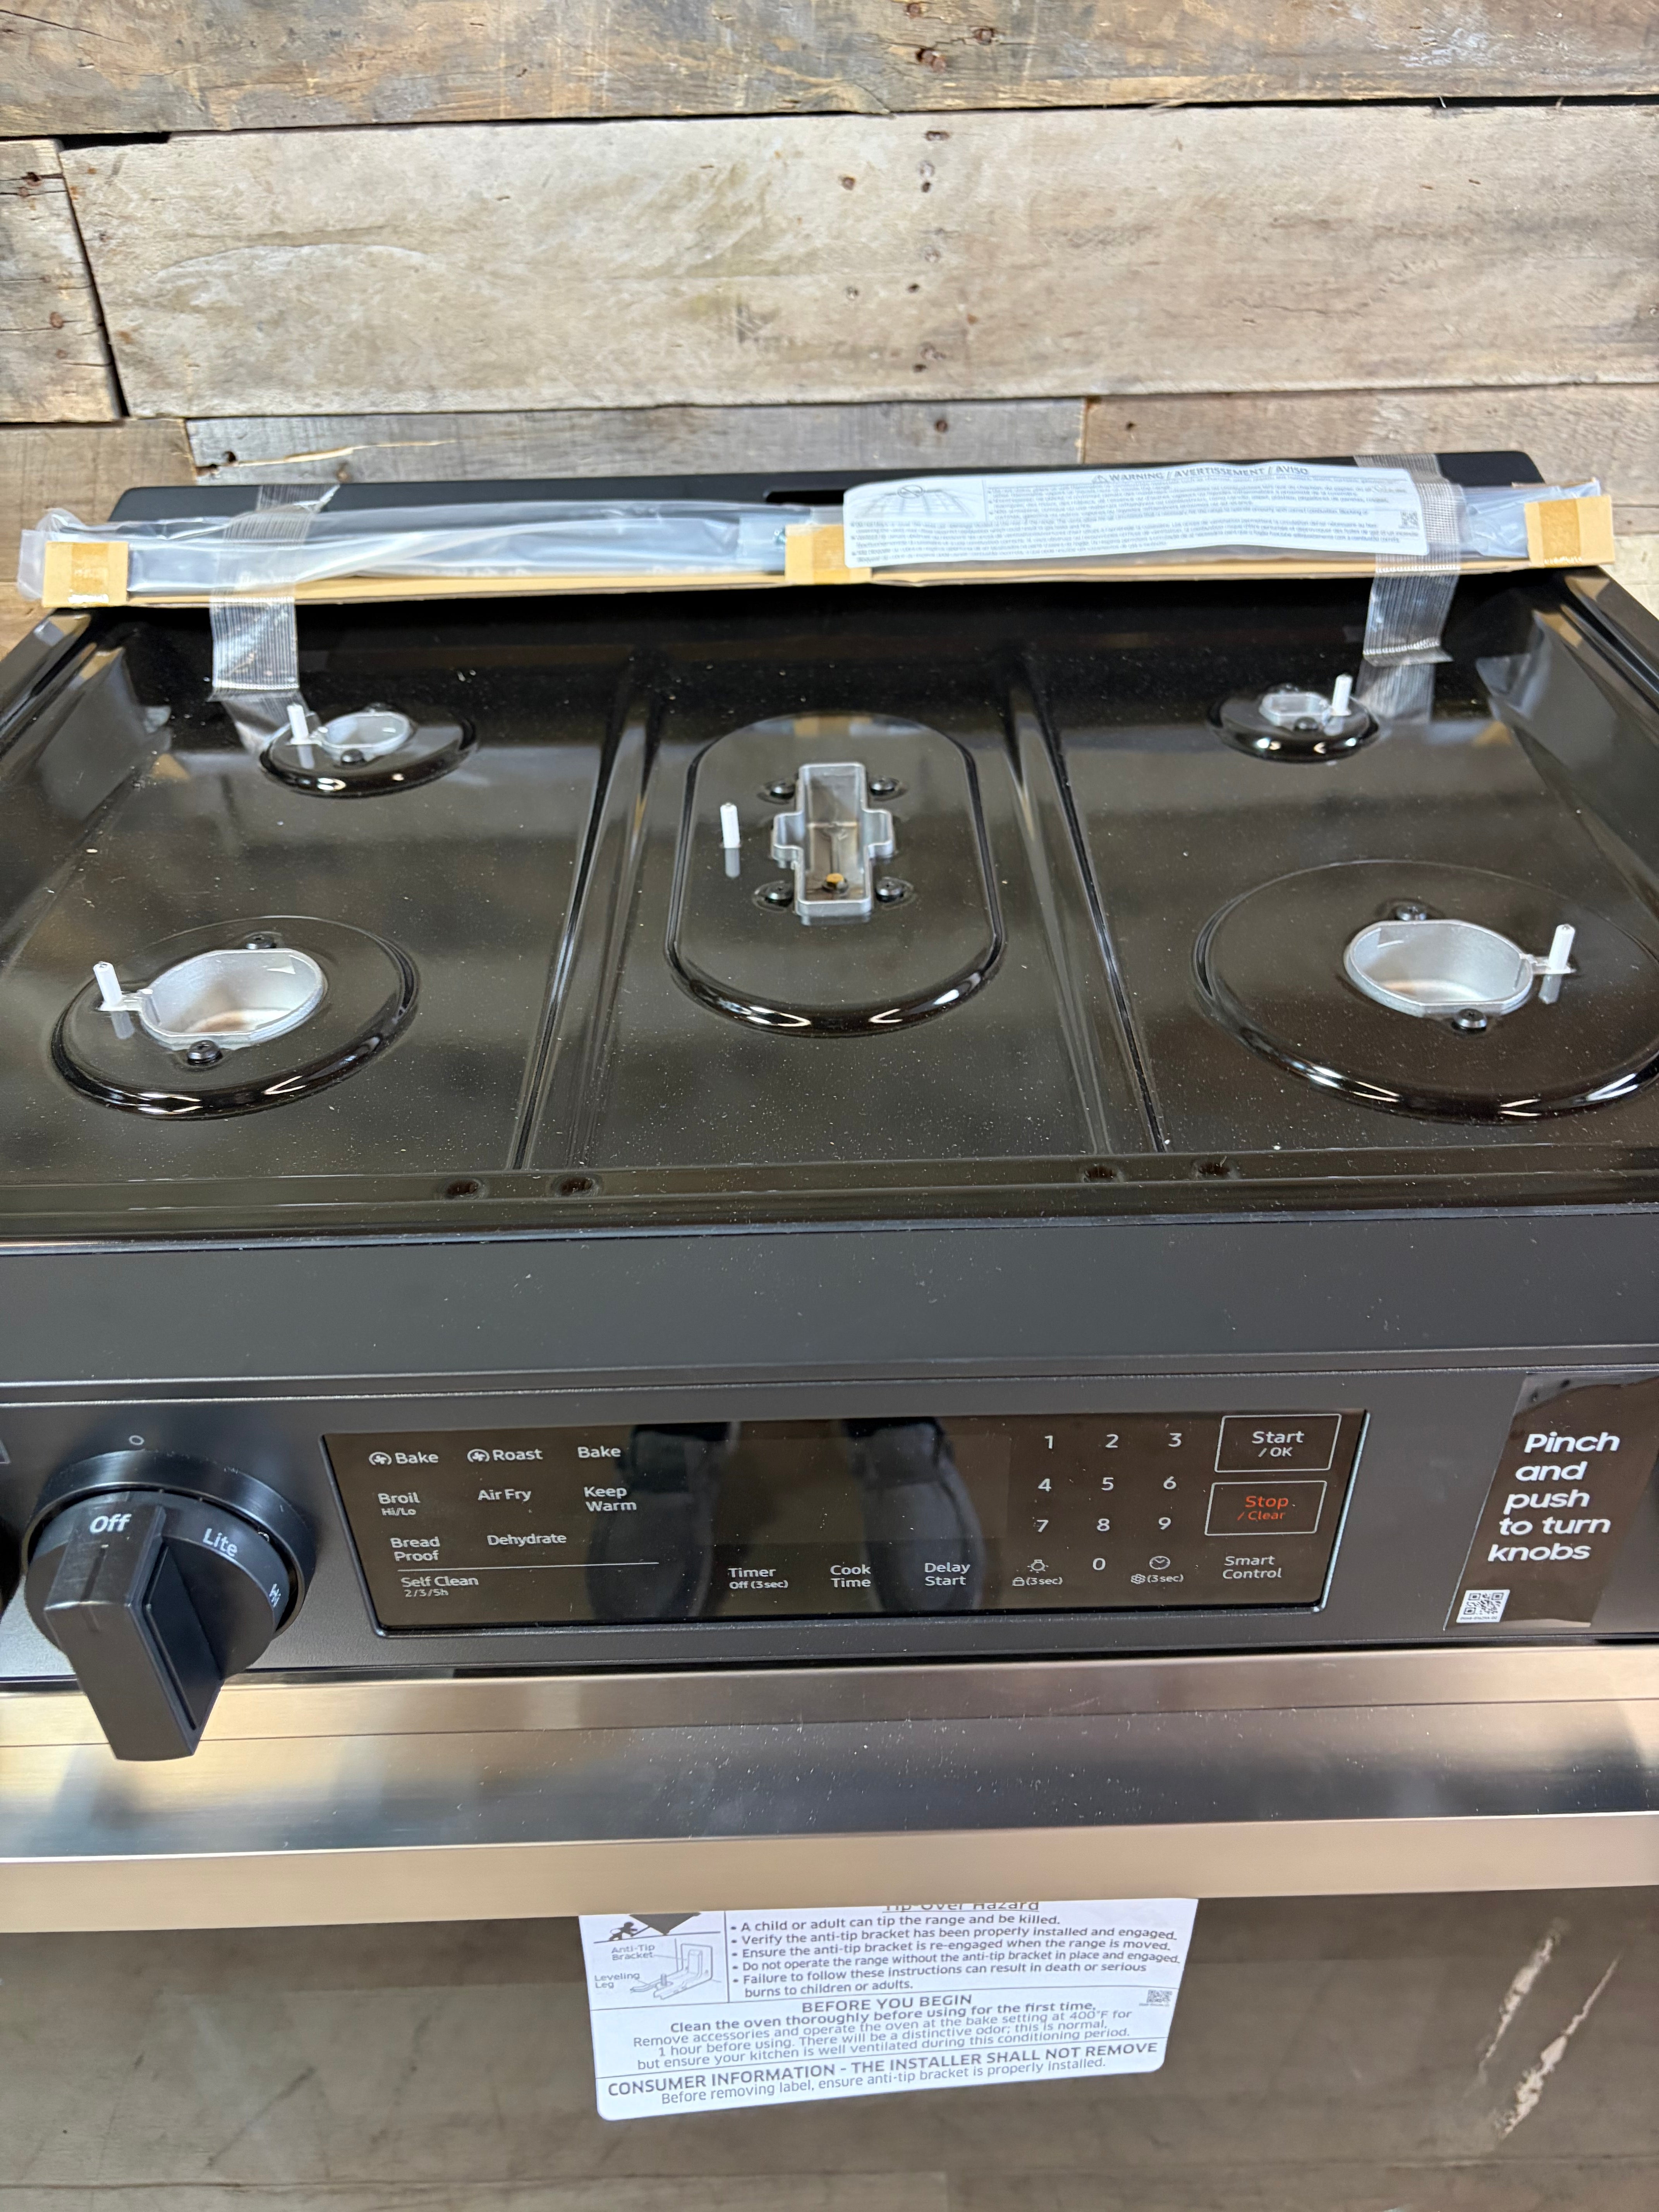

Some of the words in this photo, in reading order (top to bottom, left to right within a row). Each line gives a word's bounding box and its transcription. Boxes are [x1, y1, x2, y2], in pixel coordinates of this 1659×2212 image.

[1109, 472, 1162, 481] WARNING
[1174, 467, 1264, 478] AVERTISSEMENT
[1276, 465, 1309, 475] AVISO
[1044, 1435, 1053, 1449] 1
[1105, 1434, 1119, 1448] 2
[1168, 1433, 1182, 1447] 3
[1252, 1431, 1304, 1444] Start
[1524, 1432, 1620, 1453] Pinch
[395, 1451, 438, 1464] Bake
[493, 1449, 543, 1461] Roast
[578, 1446, 621, 1458] Bake
[1516, 1462, 1588, 1482] and
[1038, 1478, 1051, 1492] 4
[1101, 1477, 1114, 1491] 5
[1163, 1476, 1176, 1490] 6
[378, 1492, 421, 1504] Broil
[478, 1489, 502, 1501] Air
[505, 1489, 531, 1502] Fry
[584, 1486, 627, 1499] Keep
[586, 1501, 637, 1511] Warm
[1245, 1496, 1289, 1510] Stop
[1504, 1489, 1590, 1515] push
[381, 1508, 416, 1516] Hi/Lo
[1036, 1519, 1049, 1532] 7
[1097, 1518, 1110, 1531] 8
[1158, 1517, 1171, 1530] 9
[1499, 1517, 1533, 1535] to
[1542, 1517, 1611, 1534] turn
[89, 1513, 132, 1534] Off
[203, 1528, 238, 1557] Lite
[487, 1534, 567, 1547] Dehydrate
[390, 1536, 440, 1548] Bread
[394, 1550, 439, 1561] Proof
[1487, 1543, 1592, 1562] knobs
[1092, 1558, 1106, 1570] 0
[1224, 1555, 1275, 1566] Smart
[728, 1567, 776, 1578] Timer
[830, 1564, 871, 1575] Cook
[924, 1562, 970, 1574] Delay
[1223, 1568, 1281, 1579] Control
[400, 1576, 431, 1587] Self
[434, 1575, 479, 1587] Clean
[729, 1581, 749, 1589] Off
[831, 1577, 871, 1587] Time
[925, 1576, 967, 1586] Start
[741, 1922, 751, 1932] A
[755, 1921, 787, 1931] child
[792, 1922, 806, 1930] or
[811, 1918, 845, 1929] adult
[850, 1919, 872, 1927] can
[877, 1916, 895, 1927] tip
[899, 1916, 921, 1925] the
[926, 1917, 965, 1926] range
[969, 1915, 994, 1923] and
[999, 1914, 1015, 1923] be
[1019, 1915, 1060, 1924] killed.
[742, 1934, 782, 1946] Verify
[786, 1934, 807, 1943] the
[811, 1931, 857, 1942] anti-tip
[862, 1929, 910, 1939] bracket
[914, 1929, 935, 1937] has
[939, 1928, 970, 1937] been
[974, 1927, 1029, 1938] properly
[1033, 1927, 1087, 1936] installed
[1119, 1930, 1177, 1940] engaged.
[611, 1944, 655, 1953] Anti-Tip
[743, 1949, 786, 1958] Ensure
[790, 1947, 810, 1956] the
[814, 1944, 860, 1955] anti-tip
[865, 1942, 912, 1952] bracket
[917, 1941, 926, 1950] is
[930, 1939, 1002, 1951] re-engaged
[1007, 1939, 1041, 1947] when
[1046, 1939, 1065, 1947] the
[1069, 1941, 1106, 1949] range
[1109, 1939, 1119, 1948] is
[1123, 1941, 1170, 1950] moved.
[612, 1952, 654, 1961] Bracket
[743, 1962, 758, 1971] Do
[762, 1961, 781, 1970] not
[785, 1959, 830, 1970] operate
[833, 1957, 852, 1966] the
[855, 1957, 888, 1966] range
[892, 1954, 937, 1963] without
[941, 1953, 959, 1962] the
[963, 1951, 1005, 1962] anti-tip
[1008, 1951, 1052, 1960] bracket
[1056, 1950, 1066, 1959] in
[1070, 1951, 1099, 1961] place
[1103, 1951, 1124, 1959] and
[1127, 1953, 1180, 1963] engaged.
[594, 1972, 640, 1981] Leveling
[744, 1974, 787, 1984] Failure
[791, 1973, 803, 1981] to
[807, 1971, 847, 1980] follow
[851, 1969, 884, 1978] these
[888, 1965, 962, 1977] instructions
[991, 1963, 1026, 1973] result
[1030, 1963, 1041, 1972] in
[1045, 1963, 1080, 1972] death
[1101, 1963, 1146, 1971] serious
[745, 1988, 780, 1997] burns
[785, 1986, 797, 1995] to
[800, 1984, 851, 1994] children
[872, 1980, 913, 1990] adults.
[802, 1999, 871, 2013] BEFORE
[876, 1997, 913, 2009] YOU
[920, 1994, 972, 2007] BEGIN
[671, 2022, 711, 2033] Clean
[716, 2020, 739, 2030] the
[744, 2018, 781, 2028] oven
[786, 2013, 869, 2025] thoroughly
[874, 2011, 922, 2021] before
[927, 2008, 966, 2017] using
[971, 2006, 993, 2015] for
[998, 2004, 1020, 2013] the
[1025, 2003, 1055, 2012] first
[608, 2075, 706, 2096] CONSUMER
[712, 2064, 835, 2086] INFORMATION
[851, 2060, 884, 2073] THE
[891, 2054, 981, 2070] INSTALLER
[987, 2050, 1040, 2063] SHALL
[1046, 2047, 1081, 2059] NOT
[1086, 2043, 1158, 2056] REMOVE
[662, 2091, 706, 2104] Before
[711, 2084, 775, 2099] removing
[780, 2080, 814, 2093] label,
[819, 2078, 863, 2089] ensure
[867, 2072, 915, 2084] anti-tip
[920, 2068, 968, 2080] bracket
[974, 2066, 983, 2076] is
[988, 2063, 1043, 2076] properly
[1048, 2058, 1105, 2071] installed.
